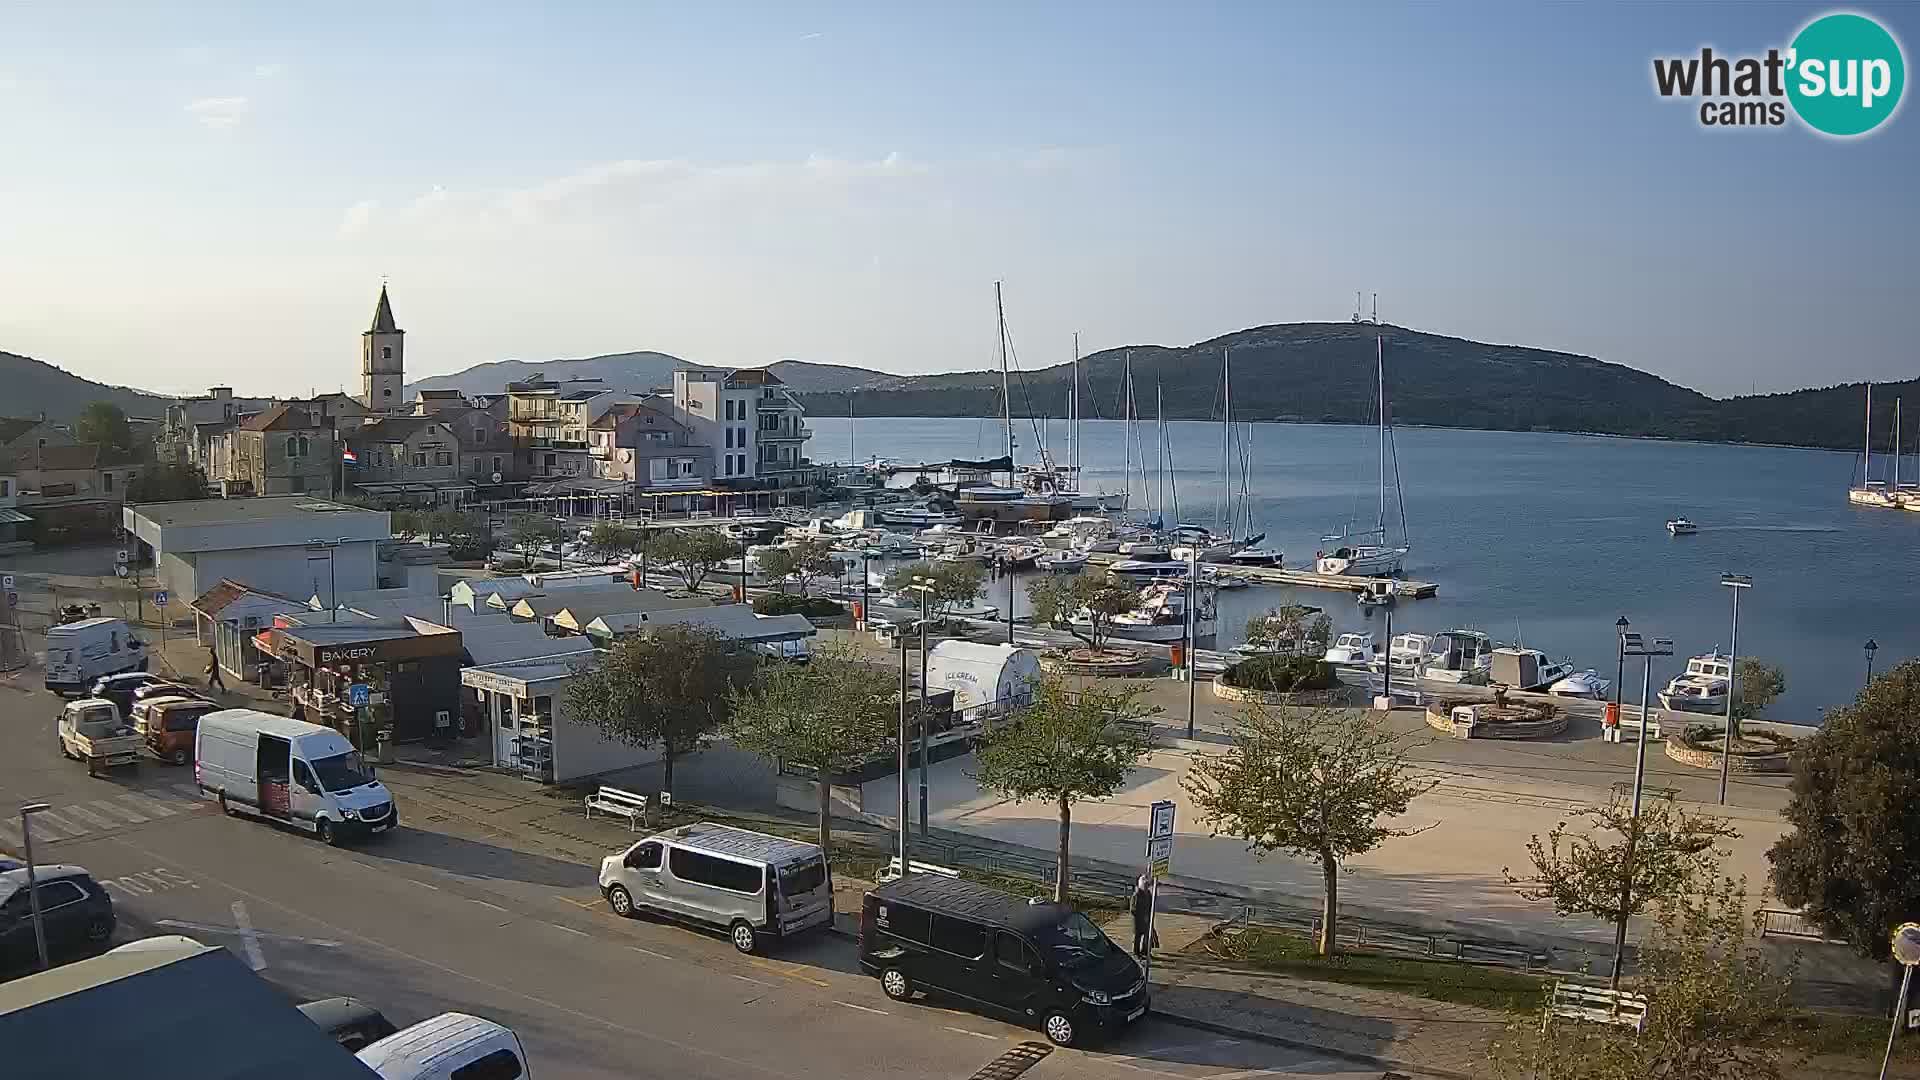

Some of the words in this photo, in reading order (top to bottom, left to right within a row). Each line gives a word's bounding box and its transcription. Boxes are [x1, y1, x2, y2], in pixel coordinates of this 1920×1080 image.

[322, 647, 377, 662] BAKERY
[945, 671, 956, 680] ICE
[956, 671, 979, 683] CREAM
